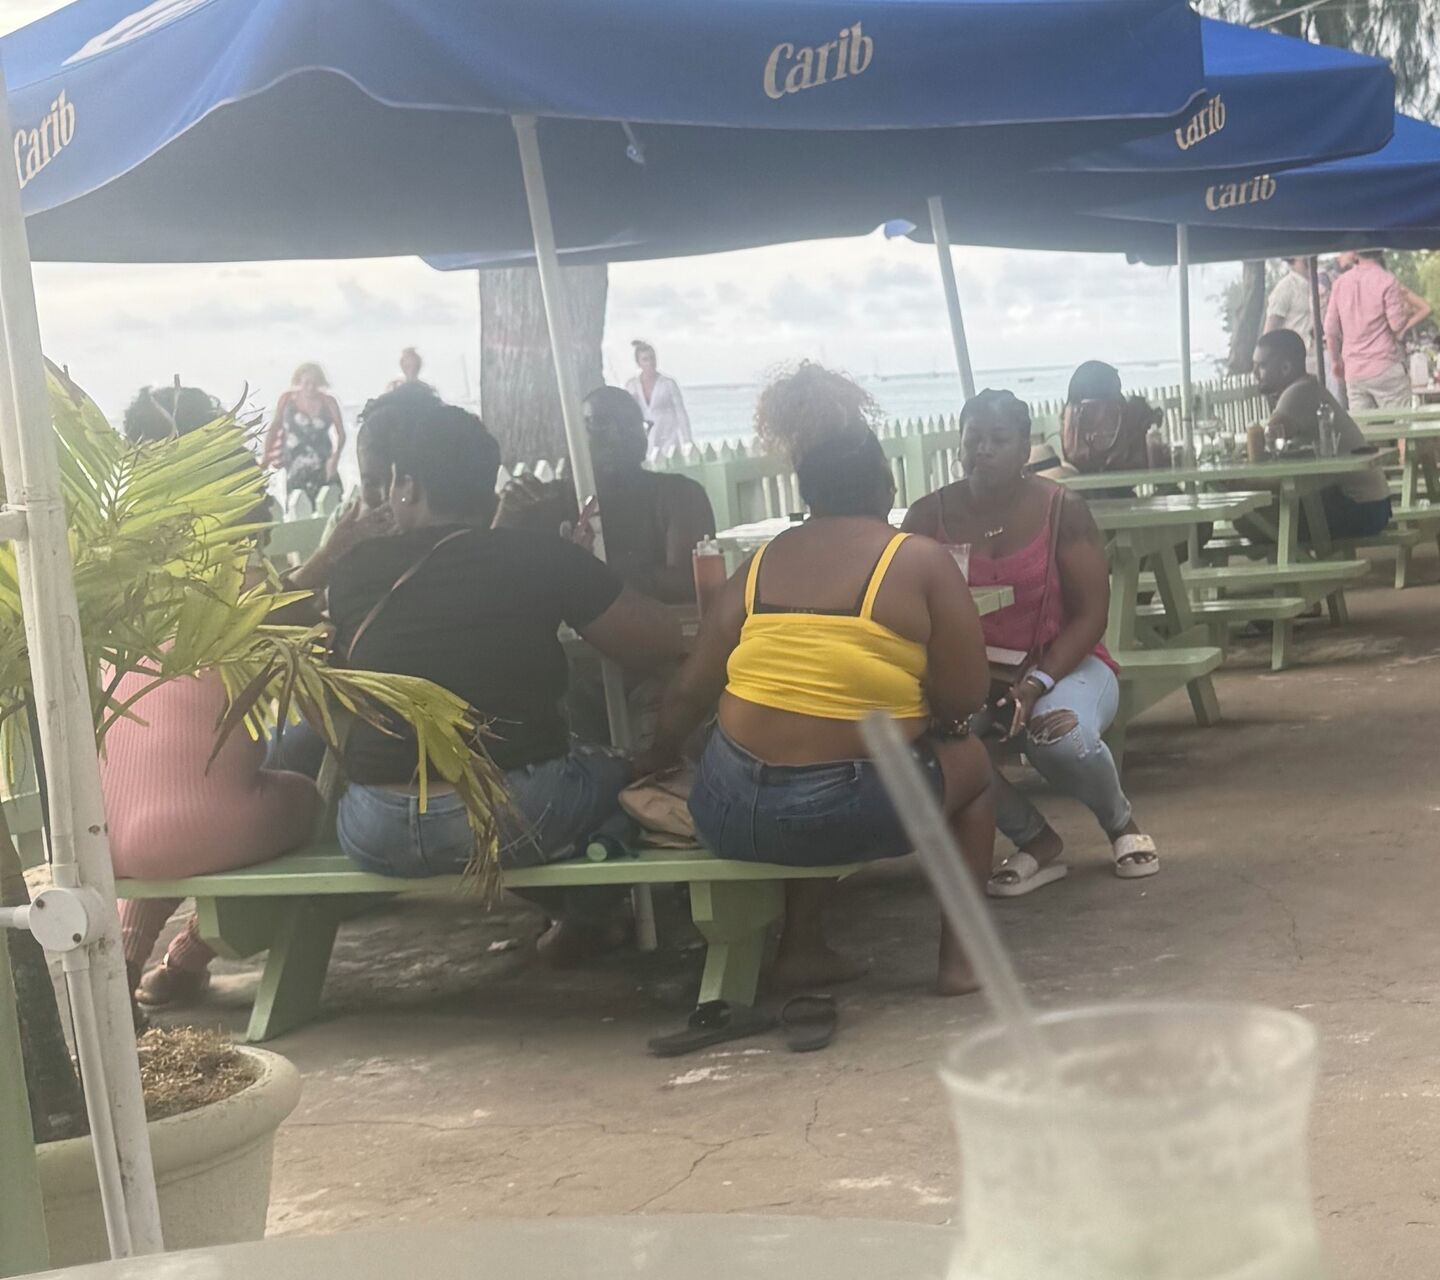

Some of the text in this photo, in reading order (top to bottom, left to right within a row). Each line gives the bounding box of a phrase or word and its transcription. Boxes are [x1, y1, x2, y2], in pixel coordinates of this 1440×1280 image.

[763, 20, 874, 99] Carib
[13, 88, 76, 190] Carib
[1204, 173, 1277, 211] Carib
